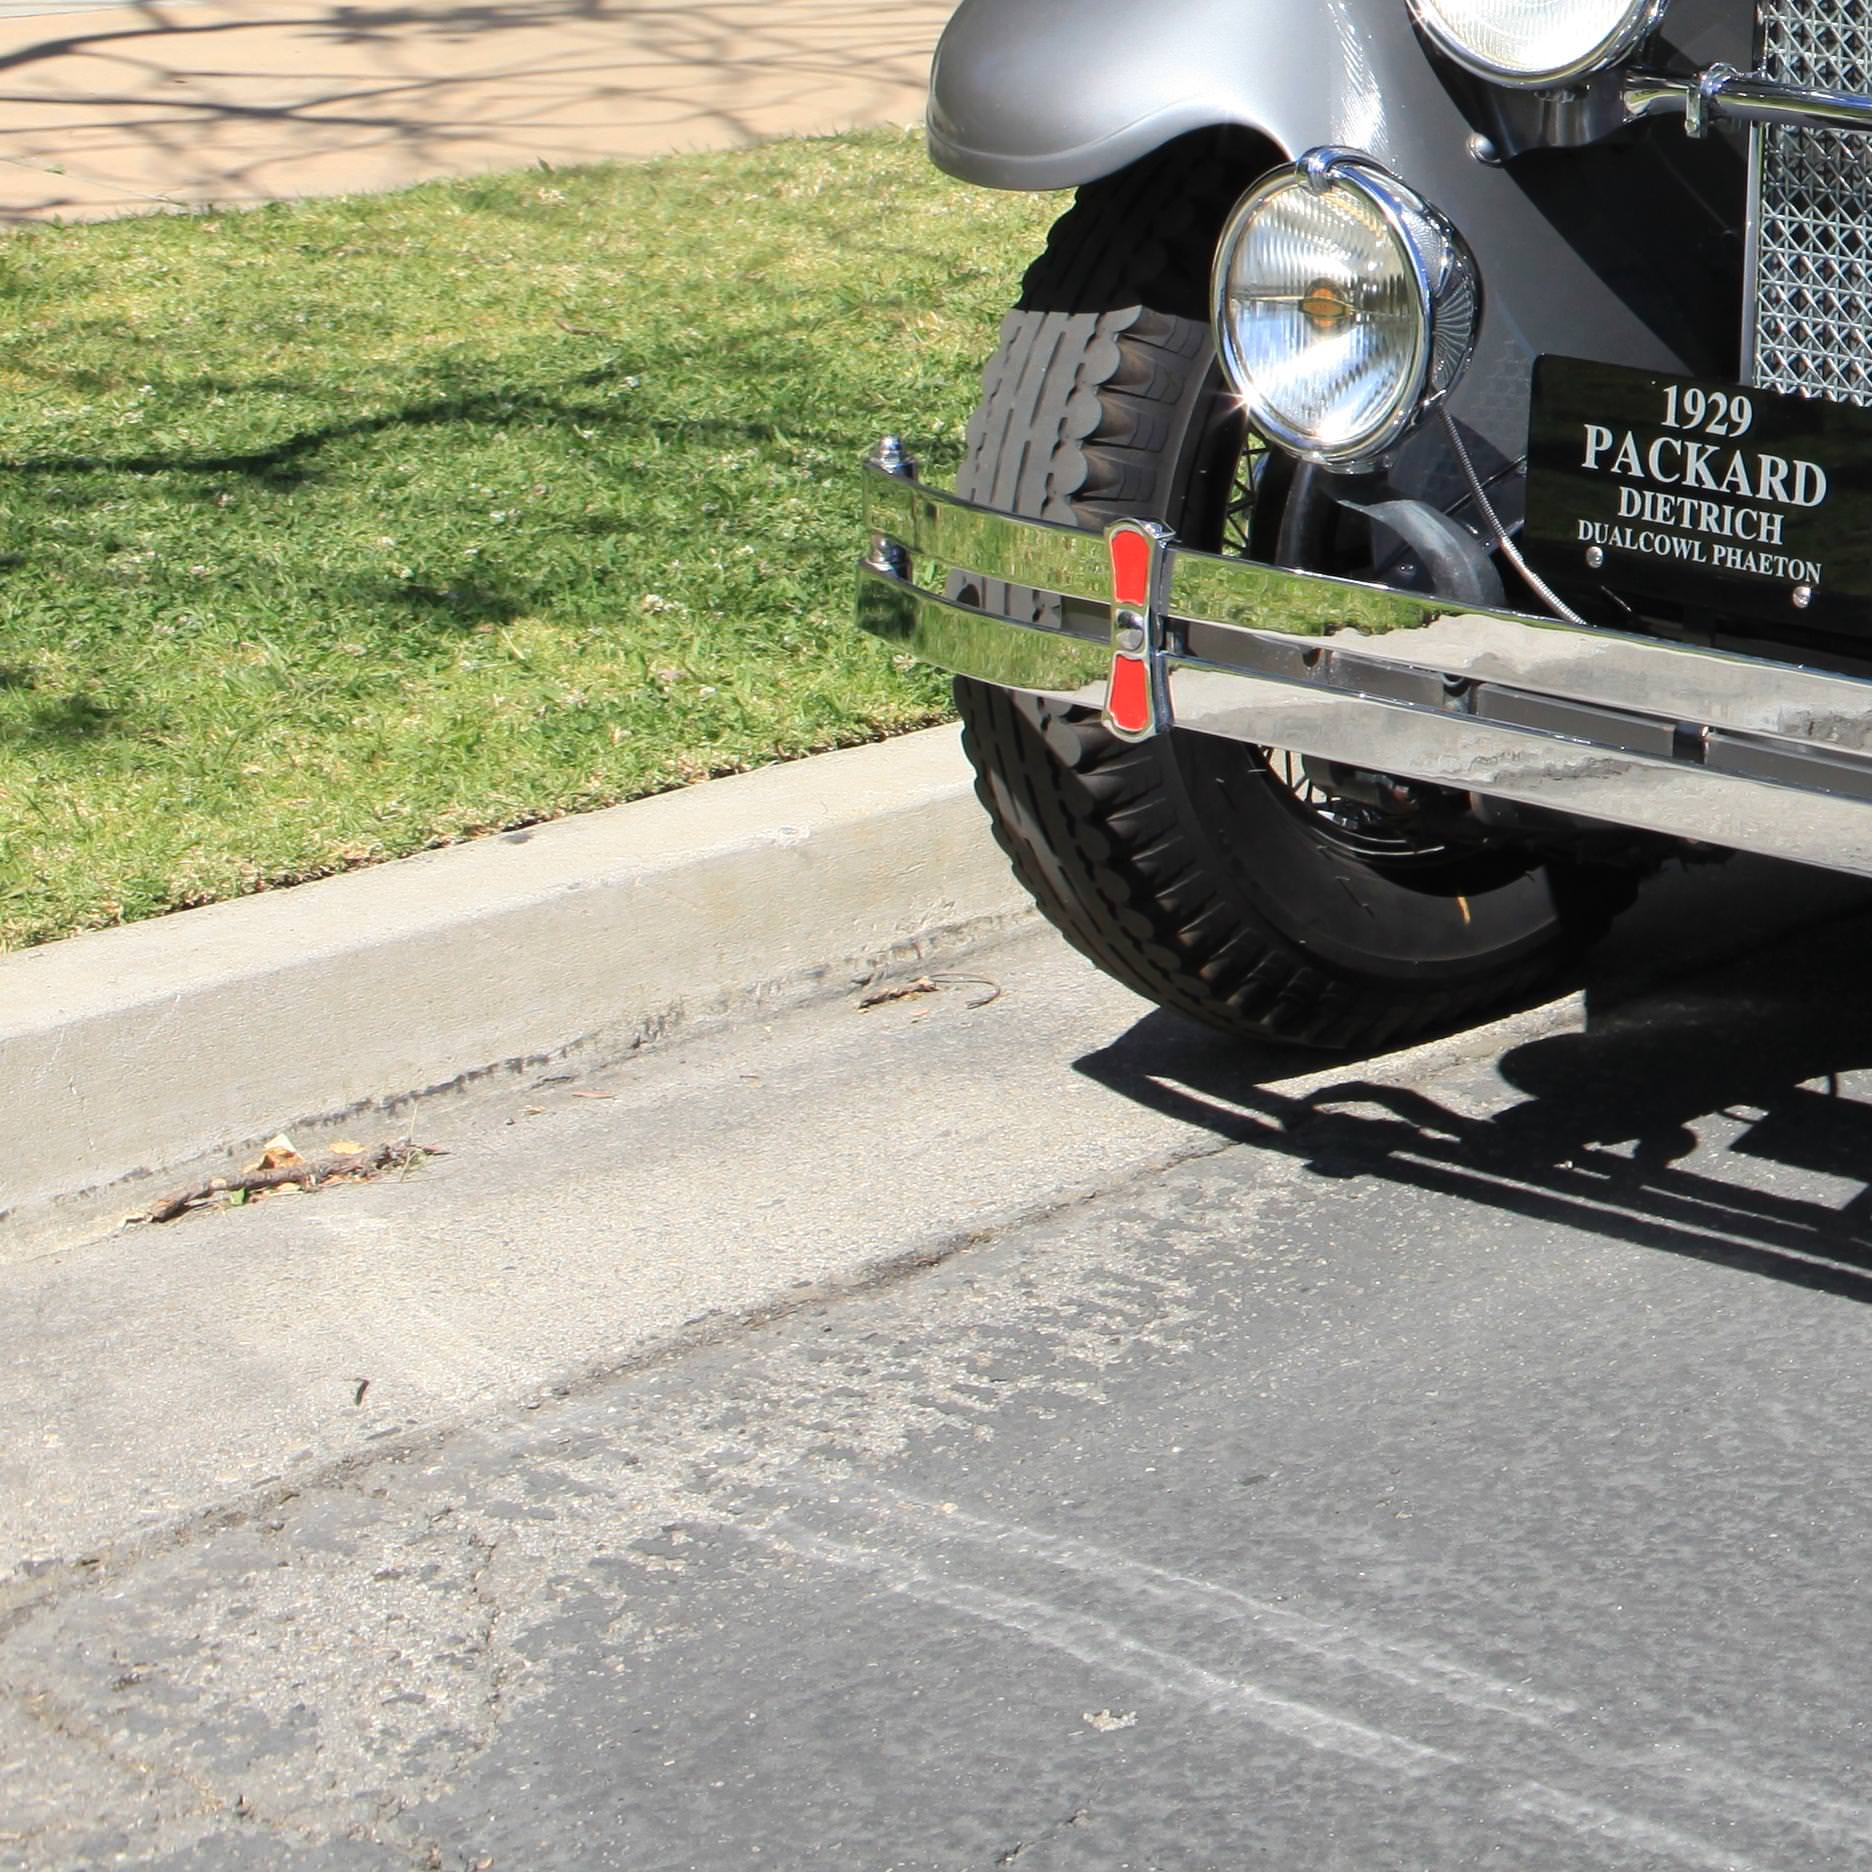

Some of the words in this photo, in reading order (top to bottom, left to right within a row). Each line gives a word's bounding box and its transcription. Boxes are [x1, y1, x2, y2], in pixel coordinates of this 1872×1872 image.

[1661, 384, 1753, 438] 1929
[1581, 423, 1827, 507] PACKARD
[1617, 486, 1785, 545] DIETRICH
[1577, 519, 1707, 563] DUALCOWL
[1711, 544, 1823, 585] PHAETON
